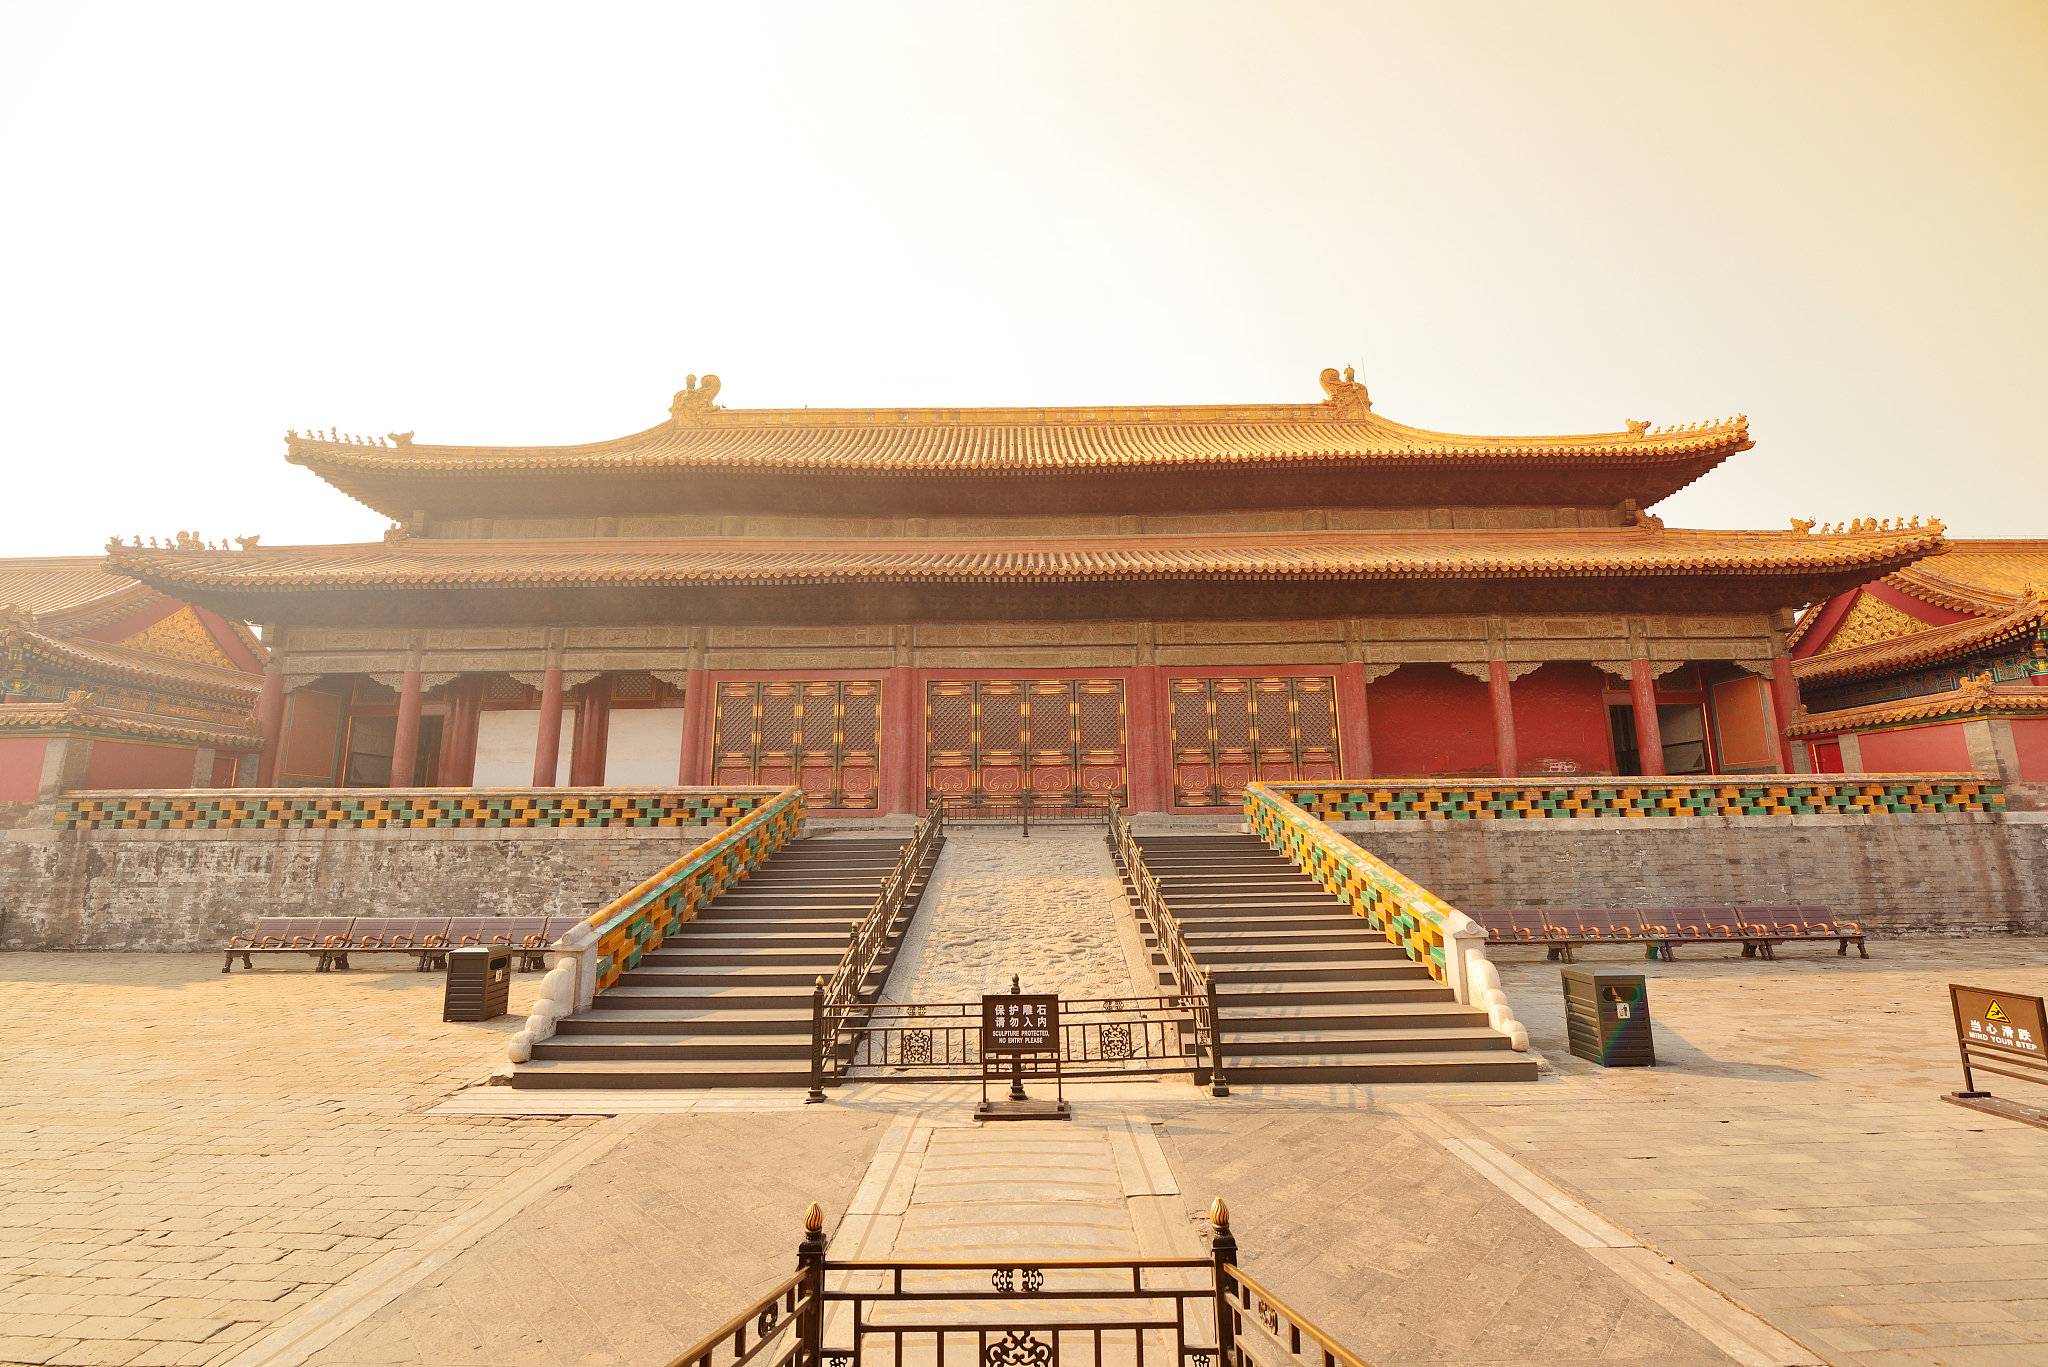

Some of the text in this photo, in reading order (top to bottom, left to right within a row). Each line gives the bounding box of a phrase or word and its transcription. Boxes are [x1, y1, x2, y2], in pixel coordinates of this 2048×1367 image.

[994, 1004, 1047, 1016] 保护雕石
[994, 1017, 1047, 1028] 请勿入内
[1970, 1020, 2032, 1042] 当心滑跌
[1968, 1032, 2037, 1050] MIND YOUR STEP
